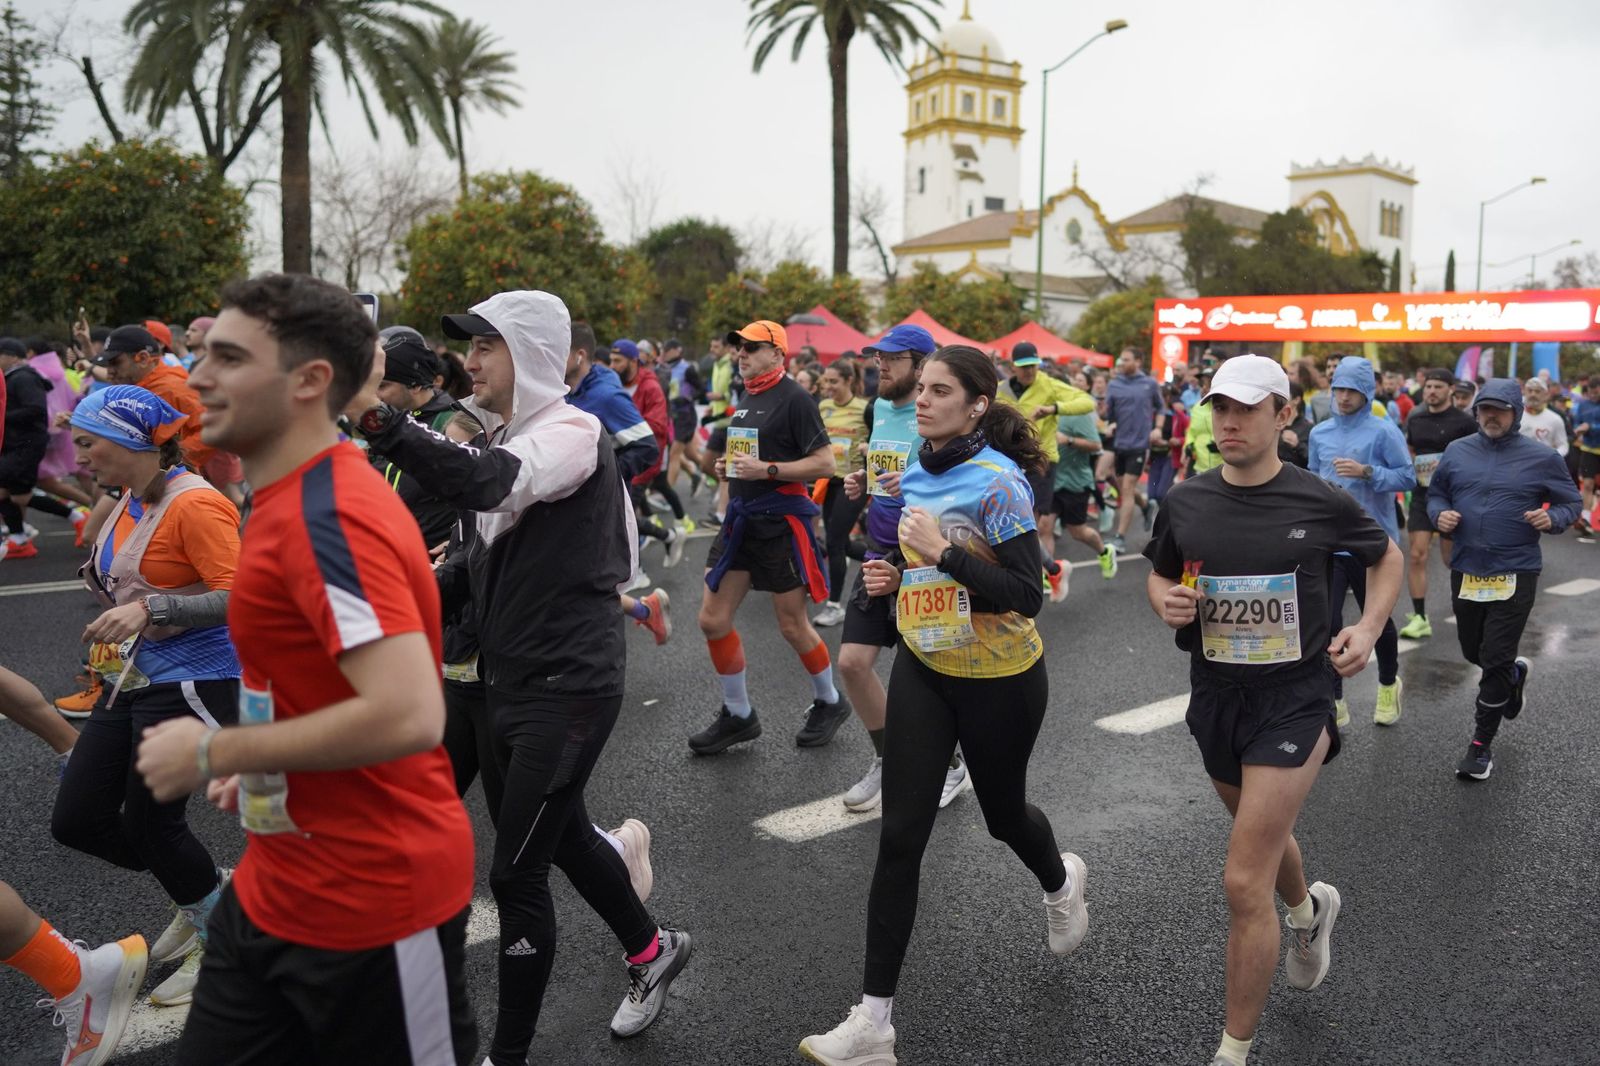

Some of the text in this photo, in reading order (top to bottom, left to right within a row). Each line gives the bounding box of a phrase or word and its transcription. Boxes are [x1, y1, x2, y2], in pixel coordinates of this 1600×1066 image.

[902, 586, 956, 616] 17387
[1205, 598, 1282, 625] 22290
[505, 948, 537, 956] adidas
